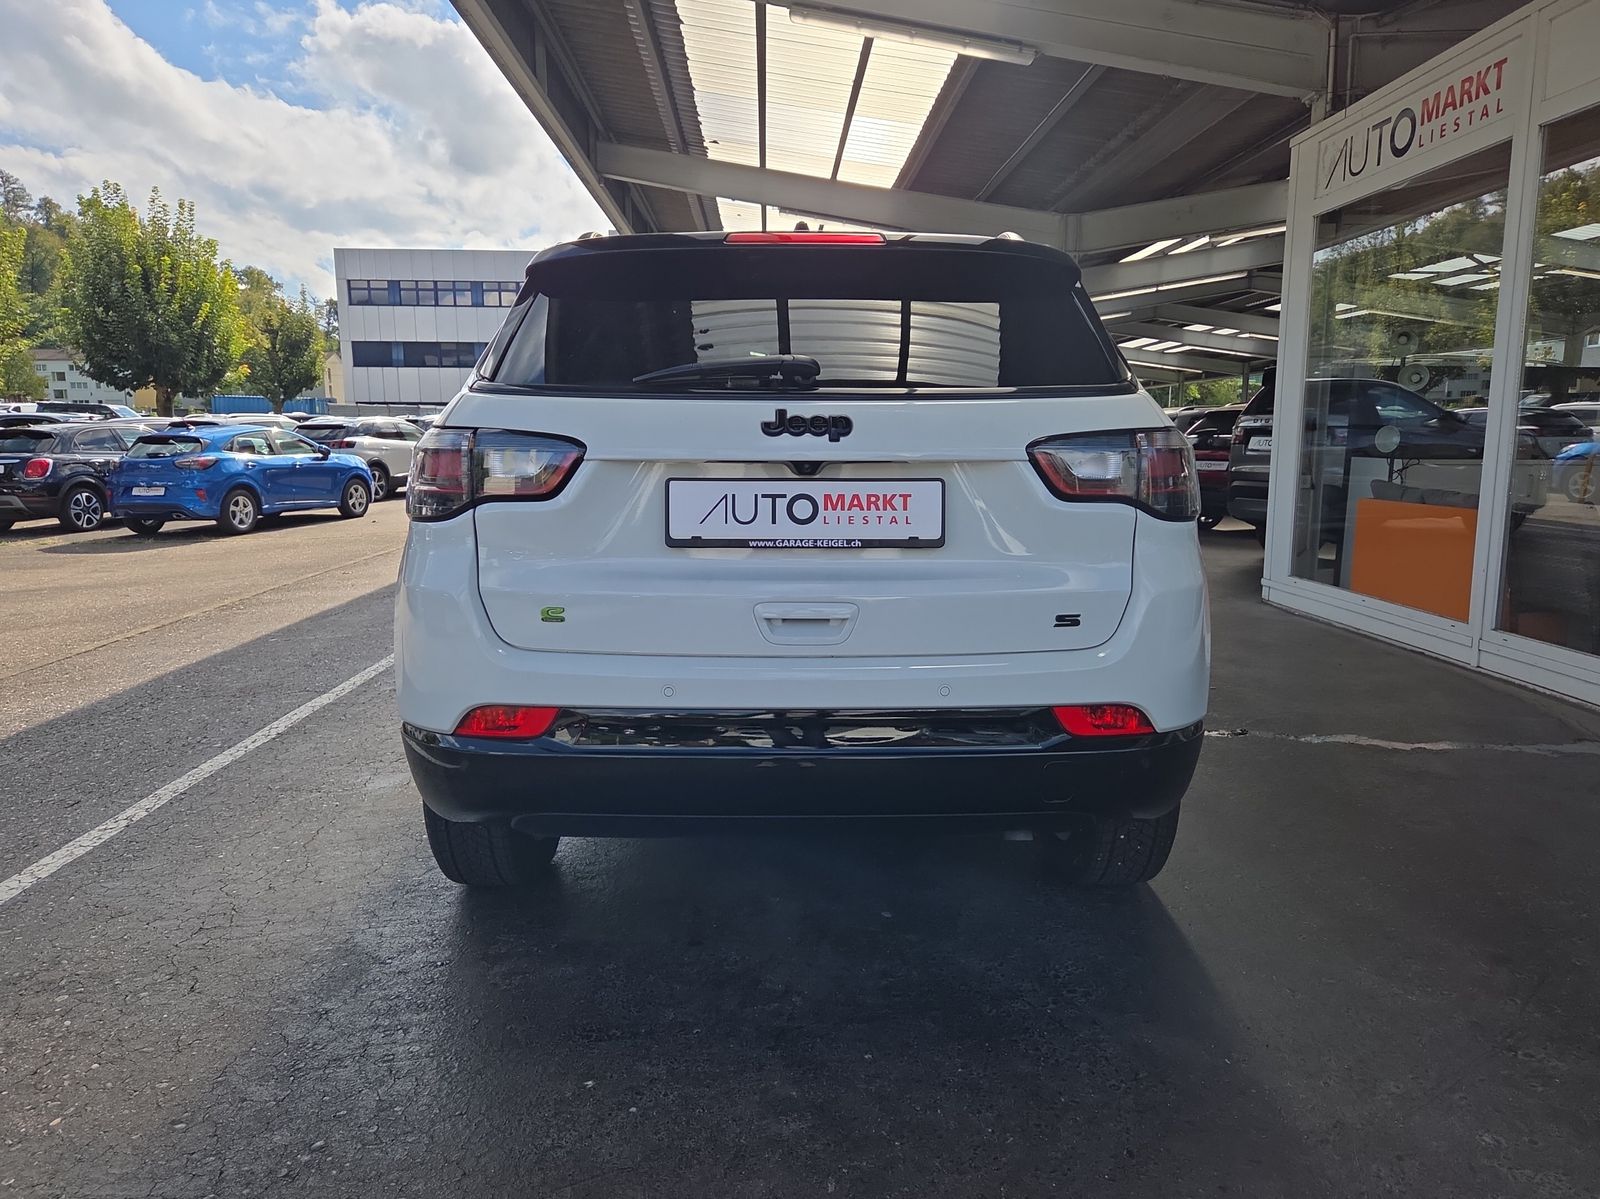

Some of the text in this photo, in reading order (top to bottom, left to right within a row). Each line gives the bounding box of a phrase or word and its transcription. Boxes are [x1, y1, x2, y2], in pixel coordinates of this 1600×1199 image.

[1325, 57, 1508, 190] AUTO MARKT
[1418, 97, 1504, 149] LIESTAL
[761, 408, 853, 442] Jeep
[699, 493, 912, 526] AUTO MARKT
[823, 515, 912, 525] LIESTAL
[748, 539, 862, 548] www.GARAGE-KEIGEL.ch
